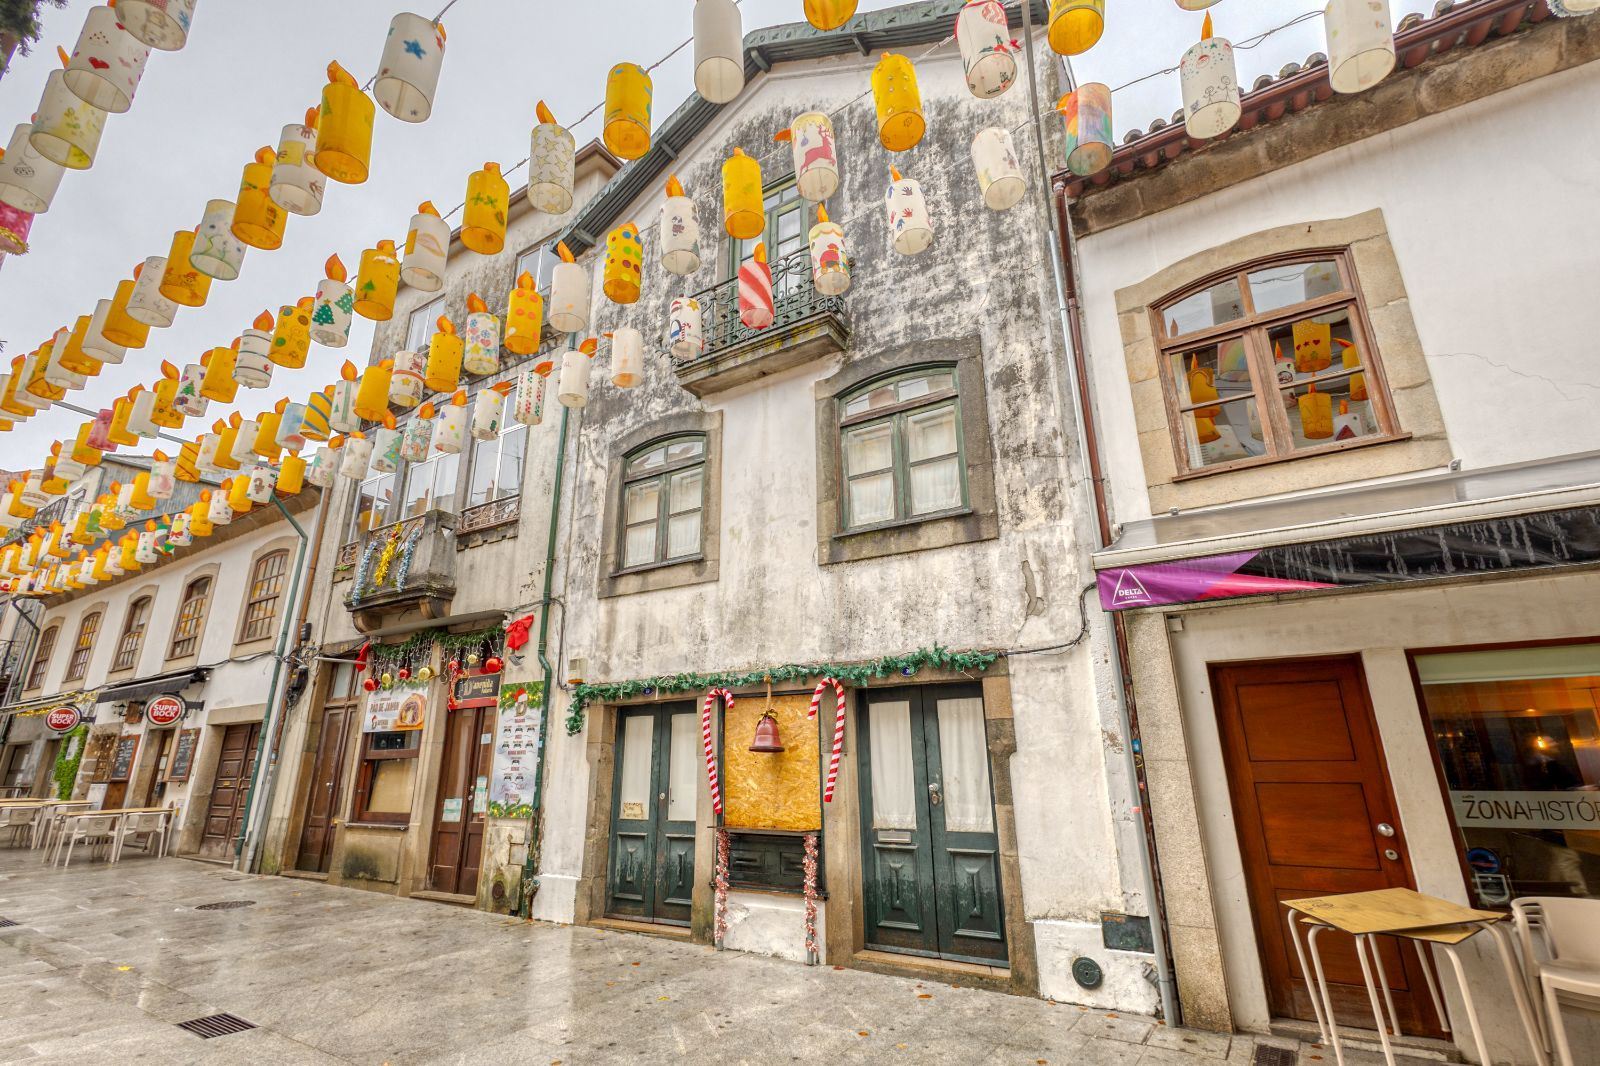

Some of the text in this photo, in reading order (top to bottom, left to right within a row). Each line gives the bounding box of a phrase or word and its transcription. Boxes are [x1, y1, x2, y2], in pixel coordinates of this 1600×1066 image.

[1118, 588, 1143, 597] DELTA
[153, 704, 179, 712] SUPER
[153, 710, 176, 718] BOCK
